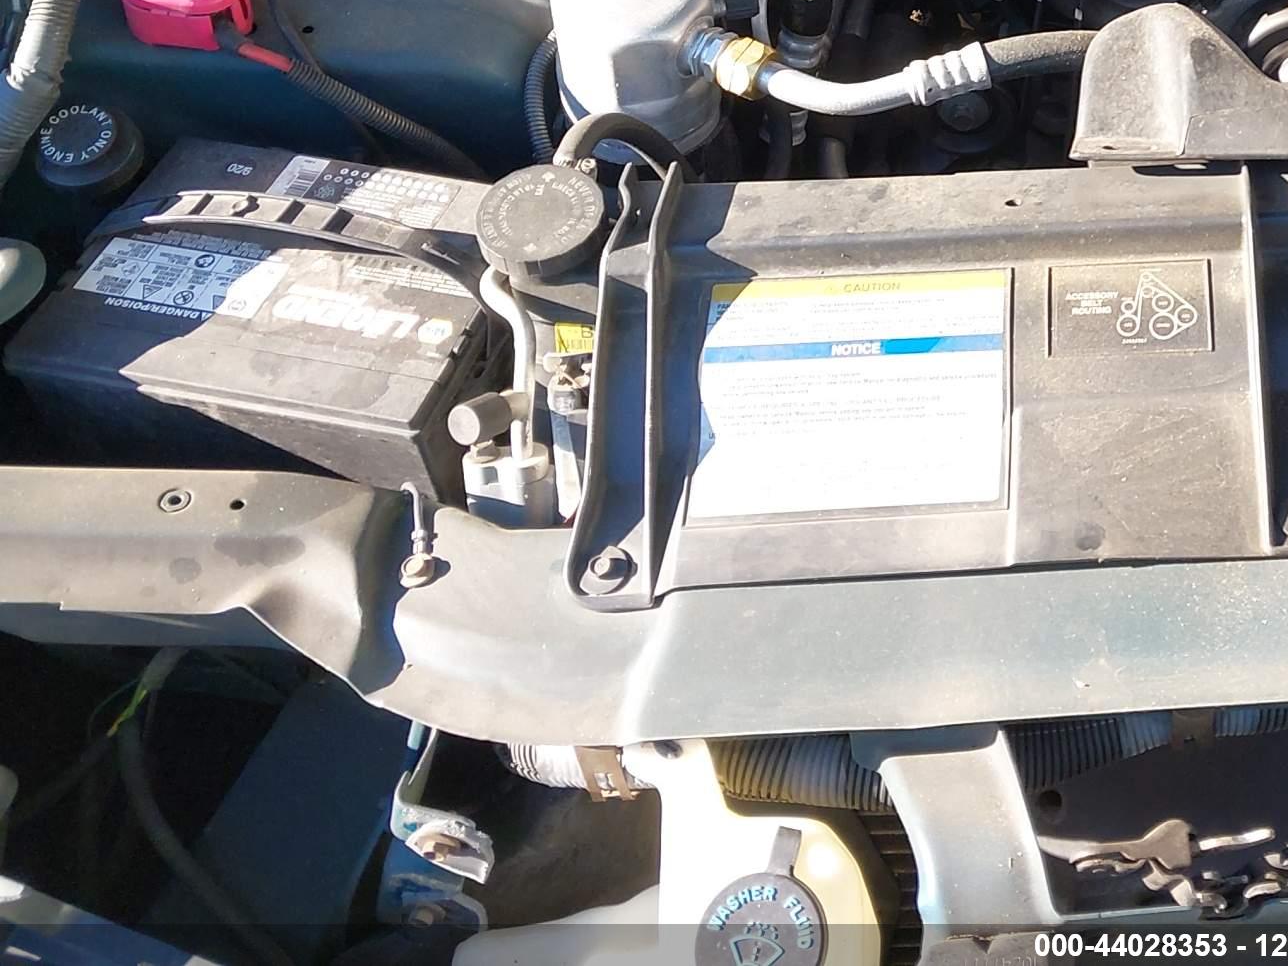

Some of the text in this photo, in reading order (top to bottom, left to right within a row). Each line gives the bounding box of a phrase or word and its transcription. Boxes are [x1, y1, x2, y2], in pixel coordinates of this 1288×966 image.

[40, 104, 113, 164] ENGINE COOLANT ONLY
[843, 281, 902, 294] CAUTION
[1064, 290, 1120, 301] ACCESSORY
[103, 296, 201, 319] DANGER/POISON
[830, 341, 882, 357] NOTICE
[706, 884, 816, 950] WASHER FLUID
